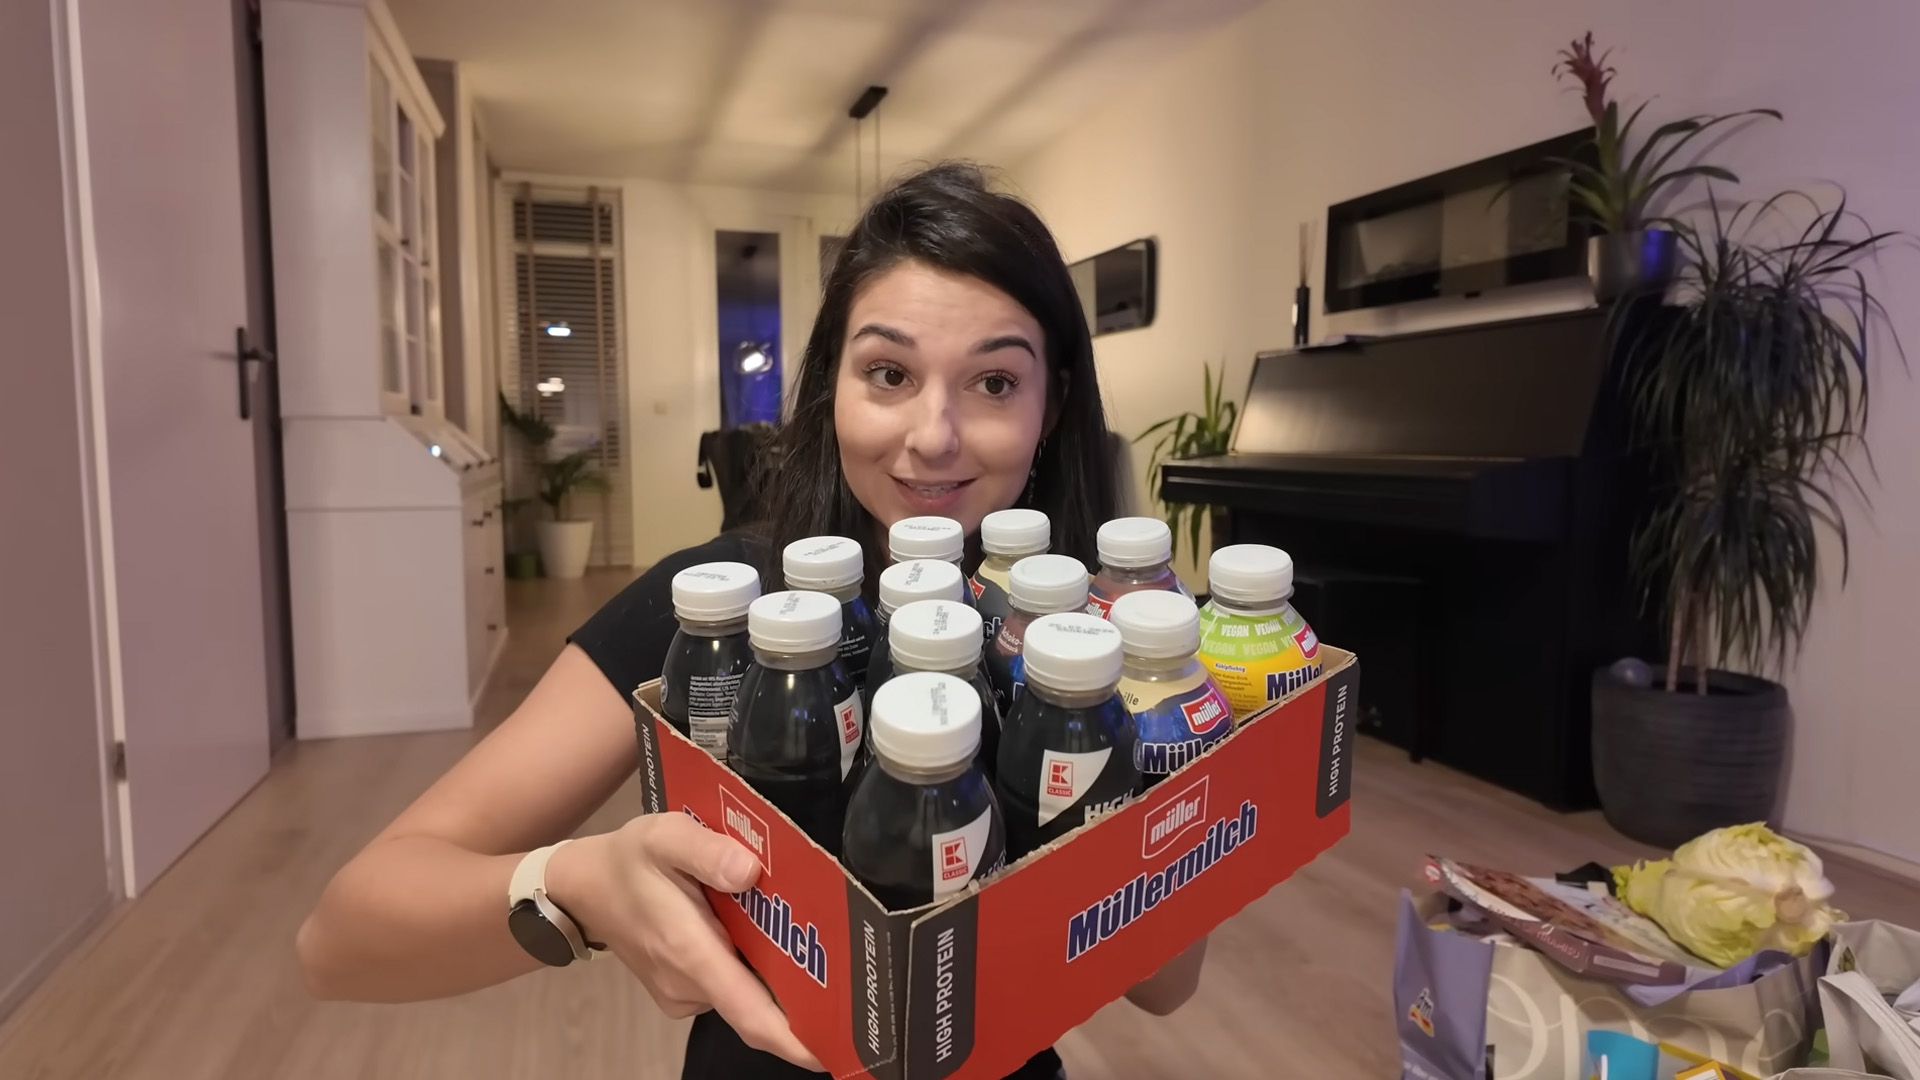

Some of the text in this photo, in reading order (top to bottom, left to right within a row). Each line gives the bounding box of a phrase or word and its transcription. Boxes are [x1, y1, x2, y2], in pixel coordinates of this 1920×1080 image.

[1202, 638, 1236, 655] VEGAN
[1242, 640, 1279, 656] VEGAN
[1221, 624, 1250, 637] VEGAN
[1254, 619, 1282, 636] VEGAN
[1191, 700, 1222, 726] müller
[642, 724, 657, 791] PROTEIN
[1329, 685, 1348, 797] HIGH PROTEIN
[1048, 787, 1072, 797] CLASSIC
[726, 806, 765, 855] müller
[1150, 797, 1201, 845] müller
[943, 865, 968, 880] CLASSIC
[1067, 799, 1258, 963] Müllermilch
[863, 920, 880, 1055] HIGH PROTEIN
[936, 927, 955, 1063] HIGH PROTEIN
